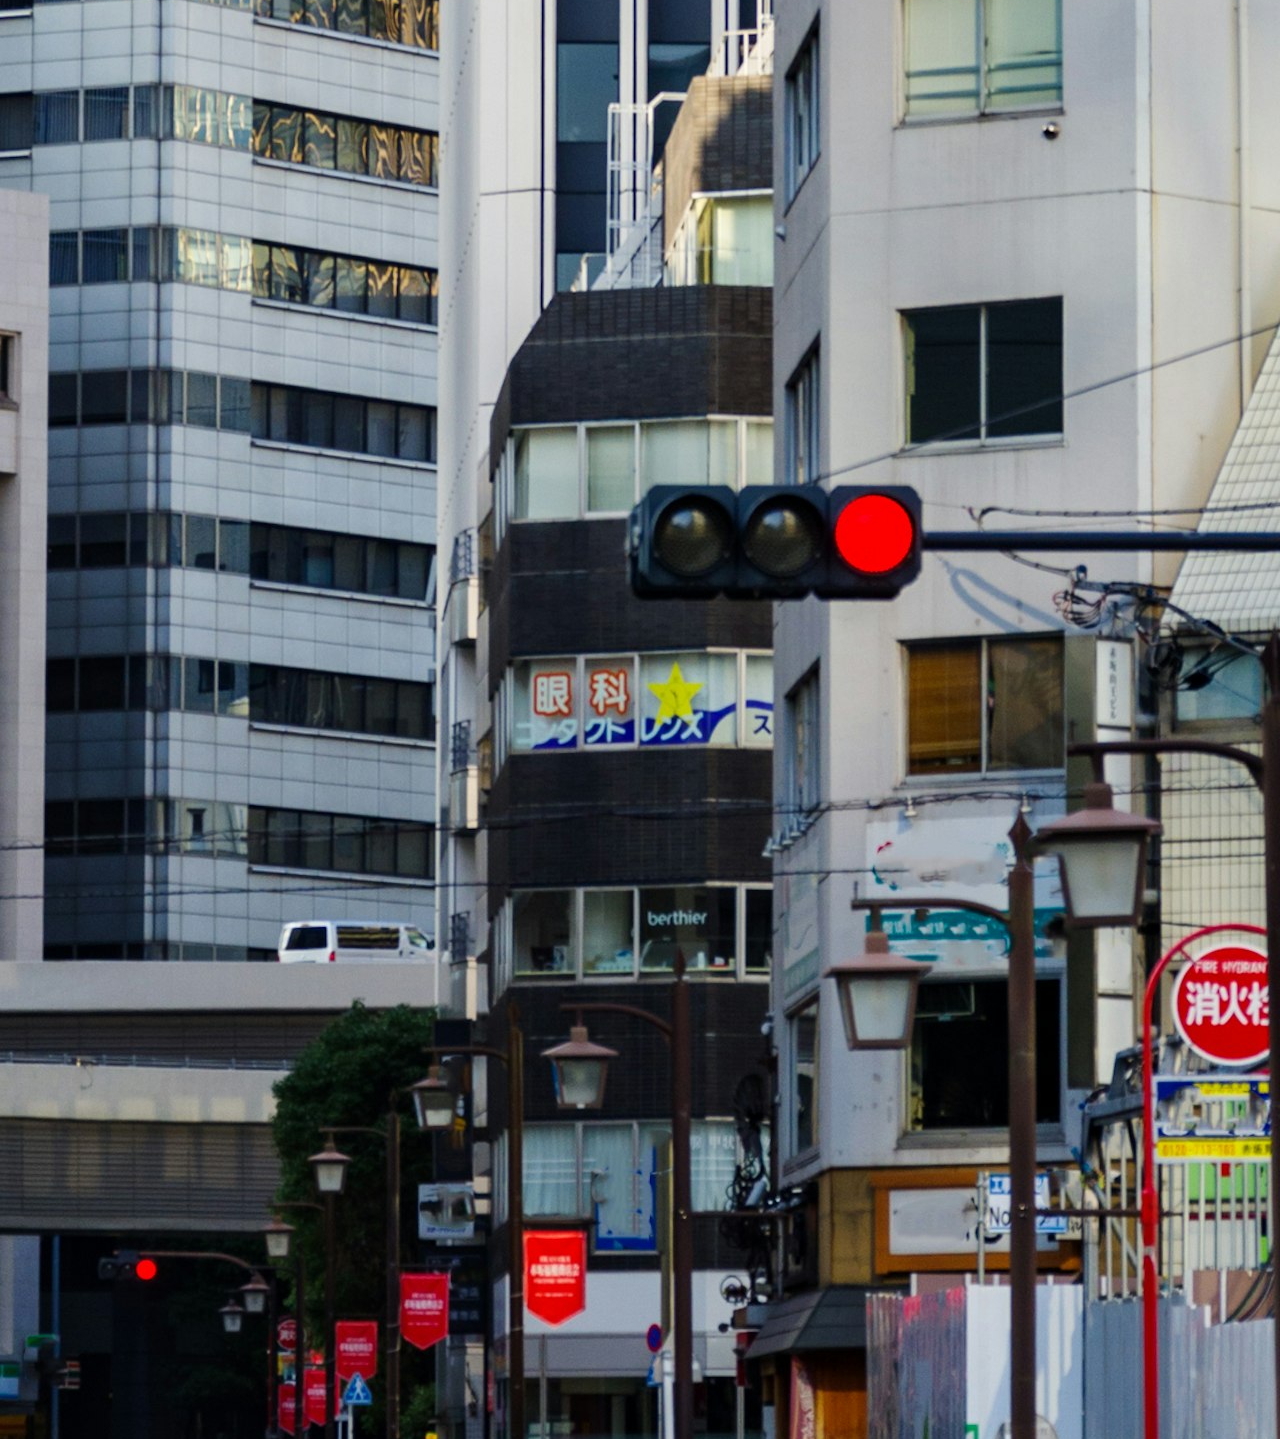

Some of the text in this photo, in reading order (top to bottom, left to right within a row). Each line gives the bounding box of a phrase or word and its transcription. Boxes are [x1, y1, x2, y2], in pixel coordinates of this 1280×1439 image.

[533, 669, 631, 718] 眼科
[516, 713, 705, 744] コンタクトレンズ
[648, 910, 708, 926] berthier
